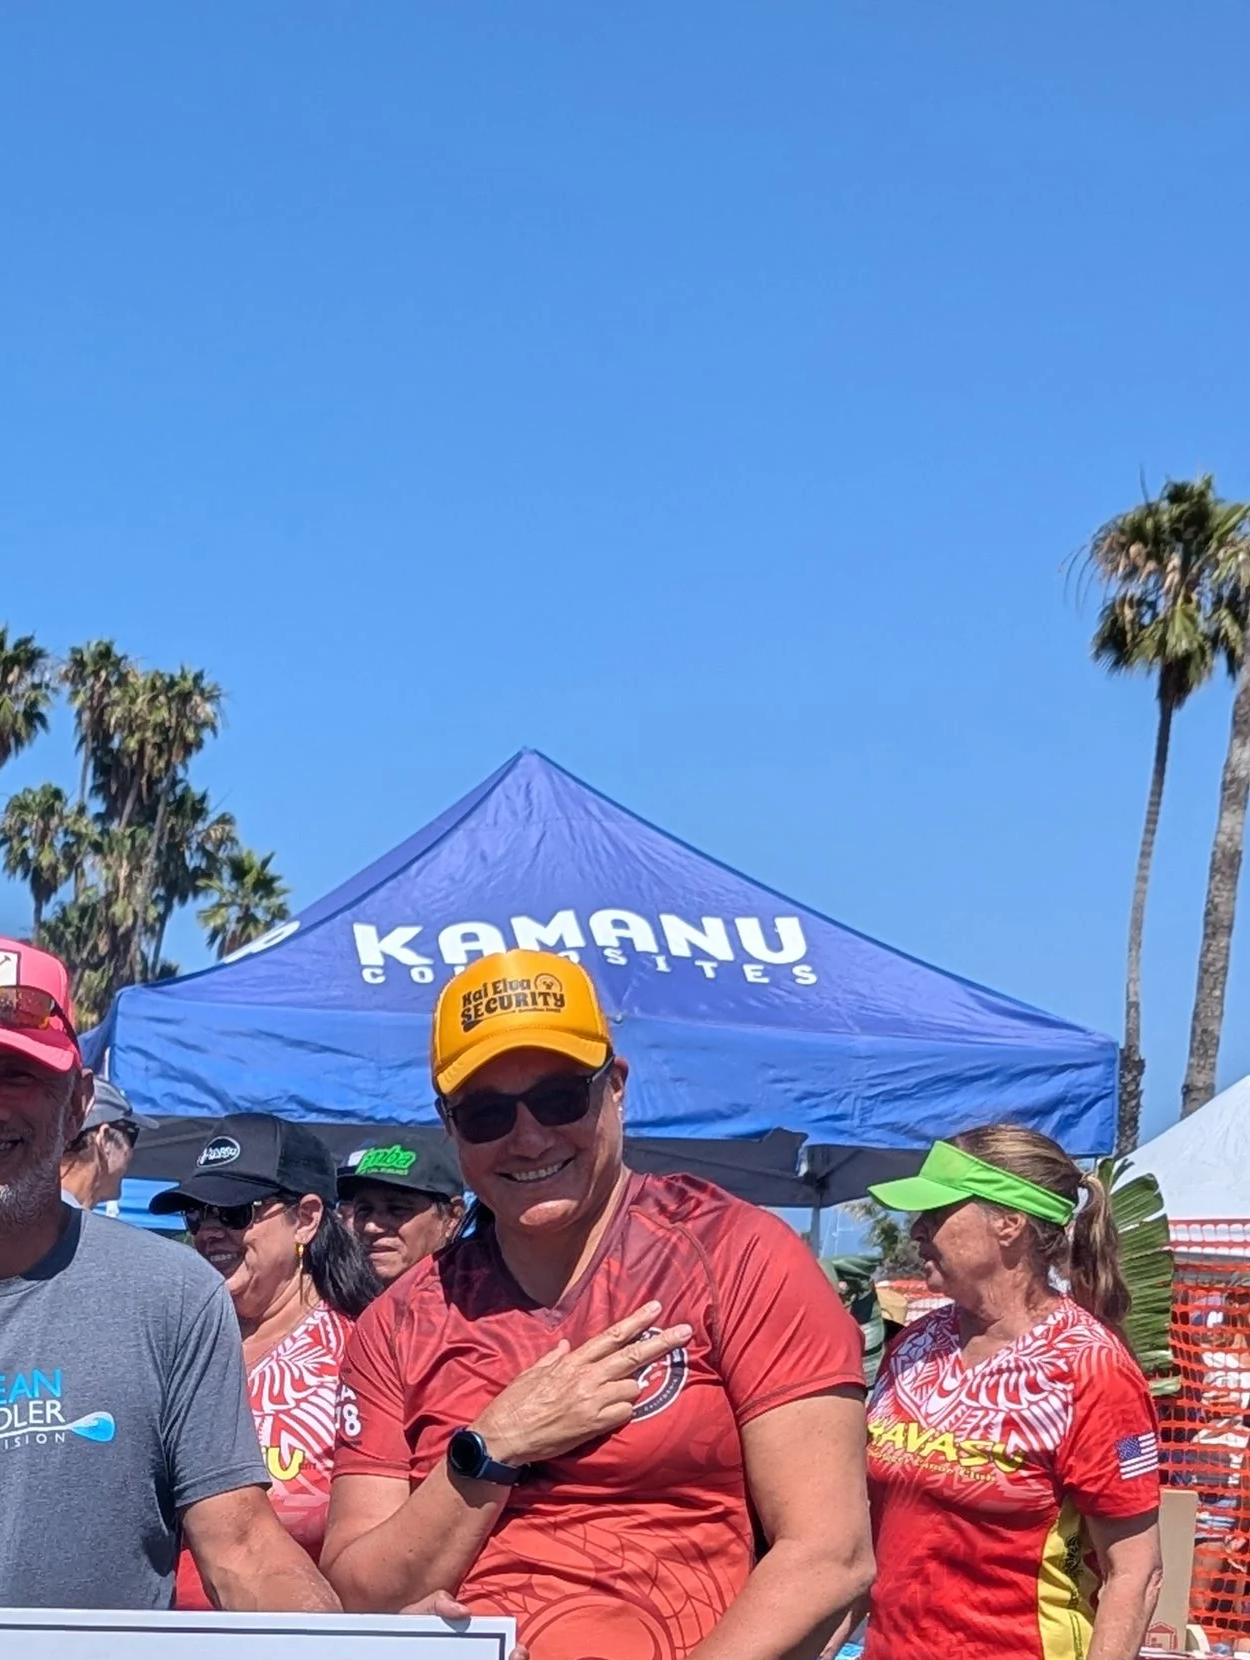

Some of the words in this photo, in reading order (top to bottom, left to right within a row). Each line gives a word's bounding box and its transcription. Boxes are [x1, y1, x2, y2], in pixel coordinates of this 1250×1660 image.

[352, 908, 808, 966] KAMANU
[361, 946, 819, 986] COSITES
[461, 991, 566, 1021] SECURITY
